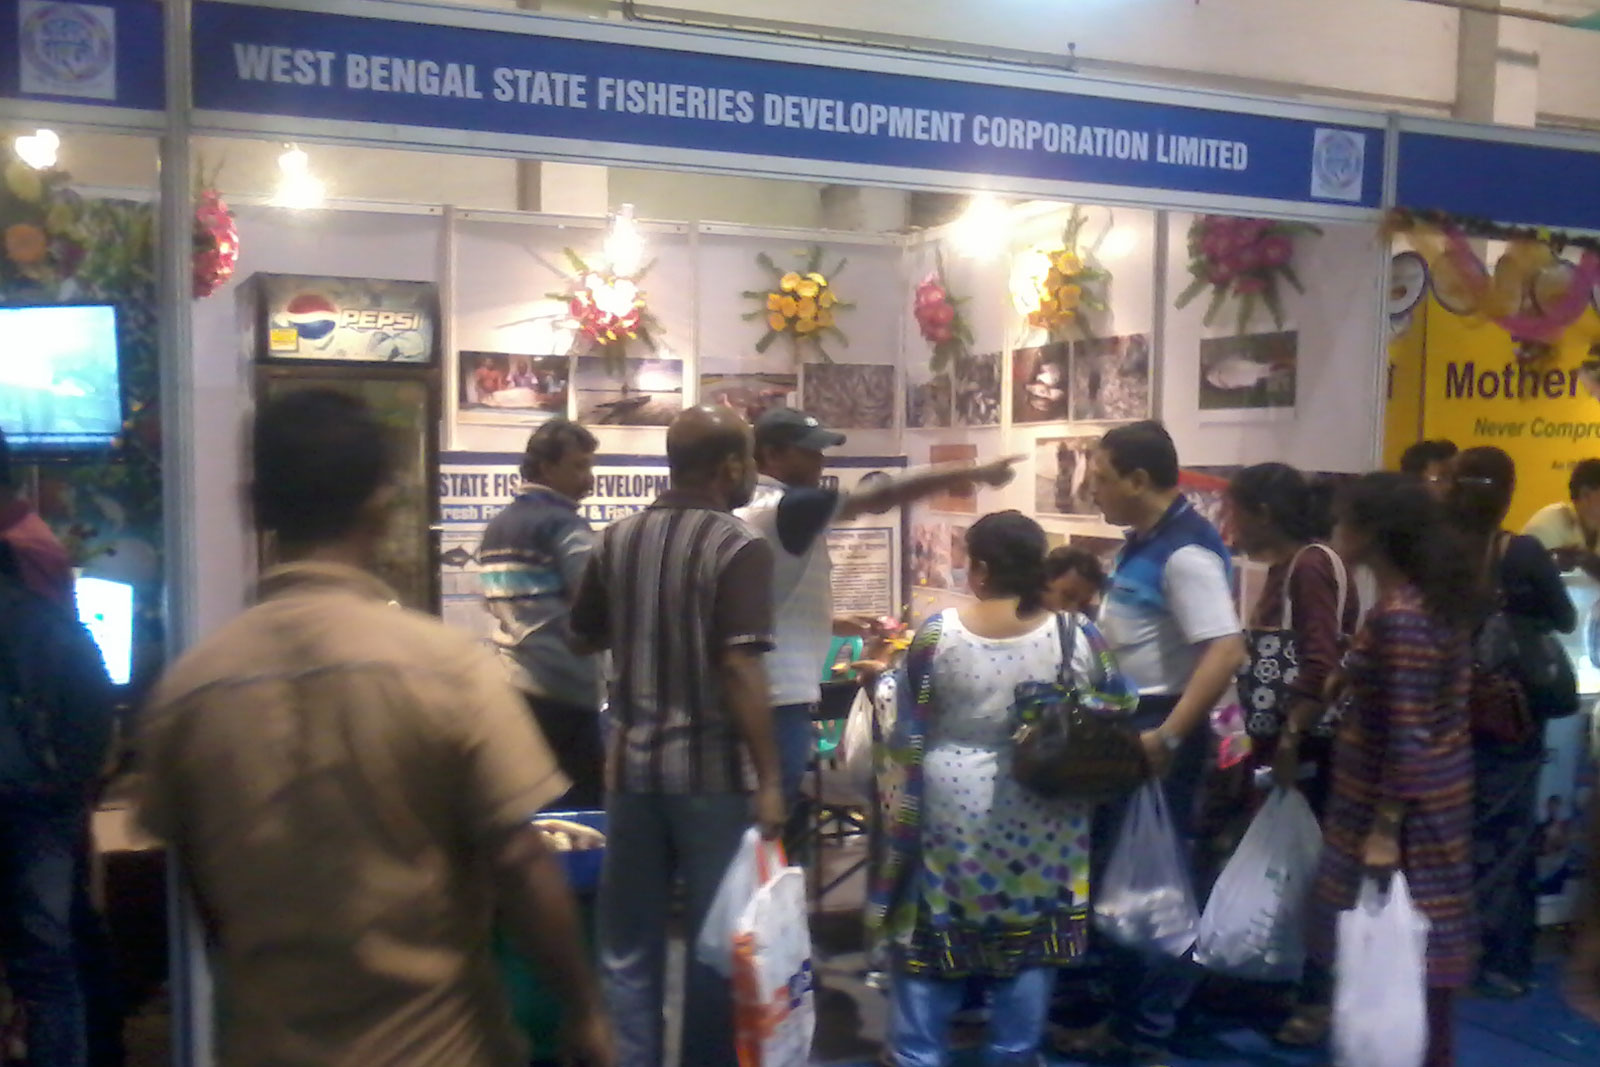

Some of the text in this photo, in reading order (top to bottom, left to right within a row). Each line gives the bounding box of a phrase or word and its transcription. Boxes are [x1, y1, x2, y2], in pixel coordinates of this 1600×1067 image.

[233, 42, 1248, 172] WEST BENGAL STATE FISHERIES DEVELOPMENT CORPORATION LIMITED
[339, 309, 420, 332] PEPSI
[1445, 361, 1578, 399] Mother
[1473, 417, 1525, 437] Never
[440, 473, 489, 497] STATE
